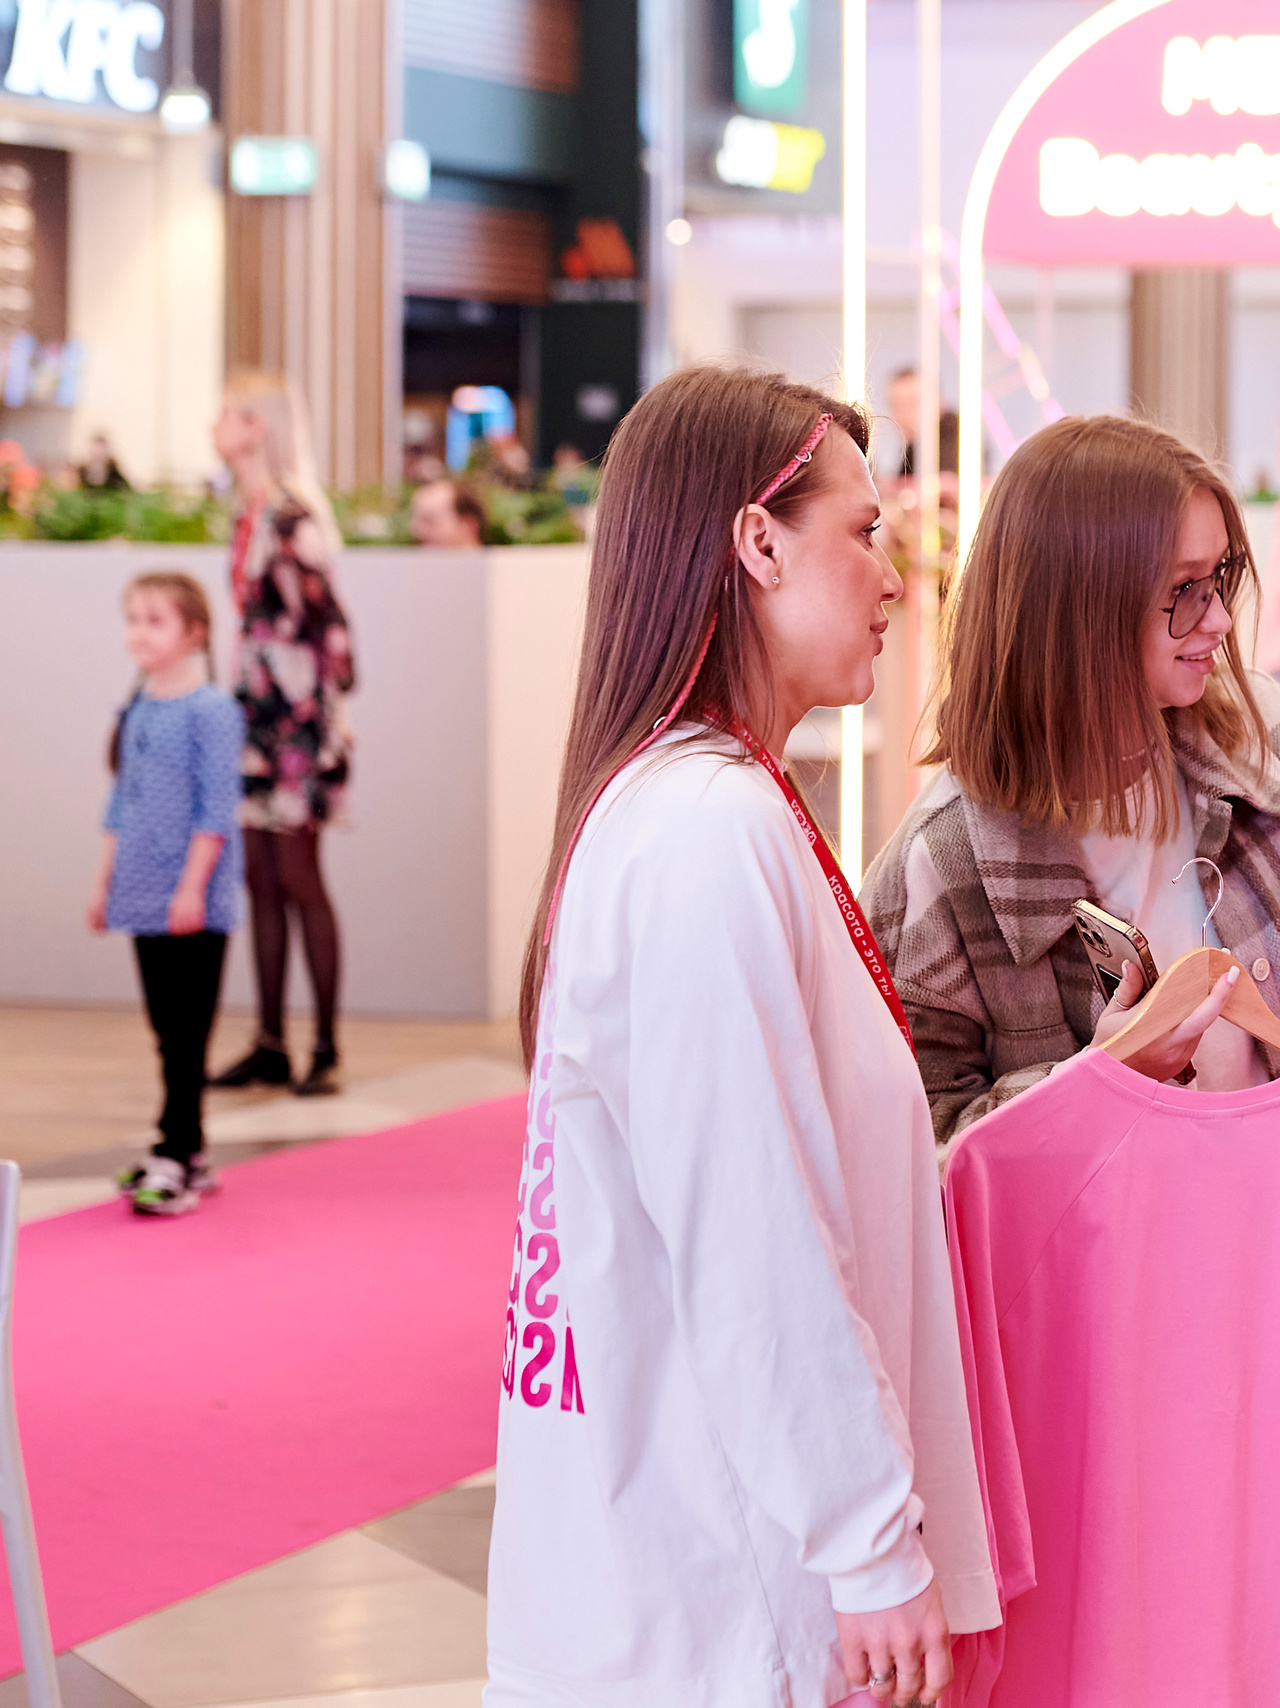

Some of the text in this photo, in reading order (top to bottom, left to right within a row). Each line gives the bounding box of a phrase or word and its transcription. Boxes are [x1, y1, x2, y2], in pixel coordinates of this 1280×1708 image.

[828, 875, 865, 938] красота
[863, 948, 882, 974] это
[878, 976, 892, 997] ты
